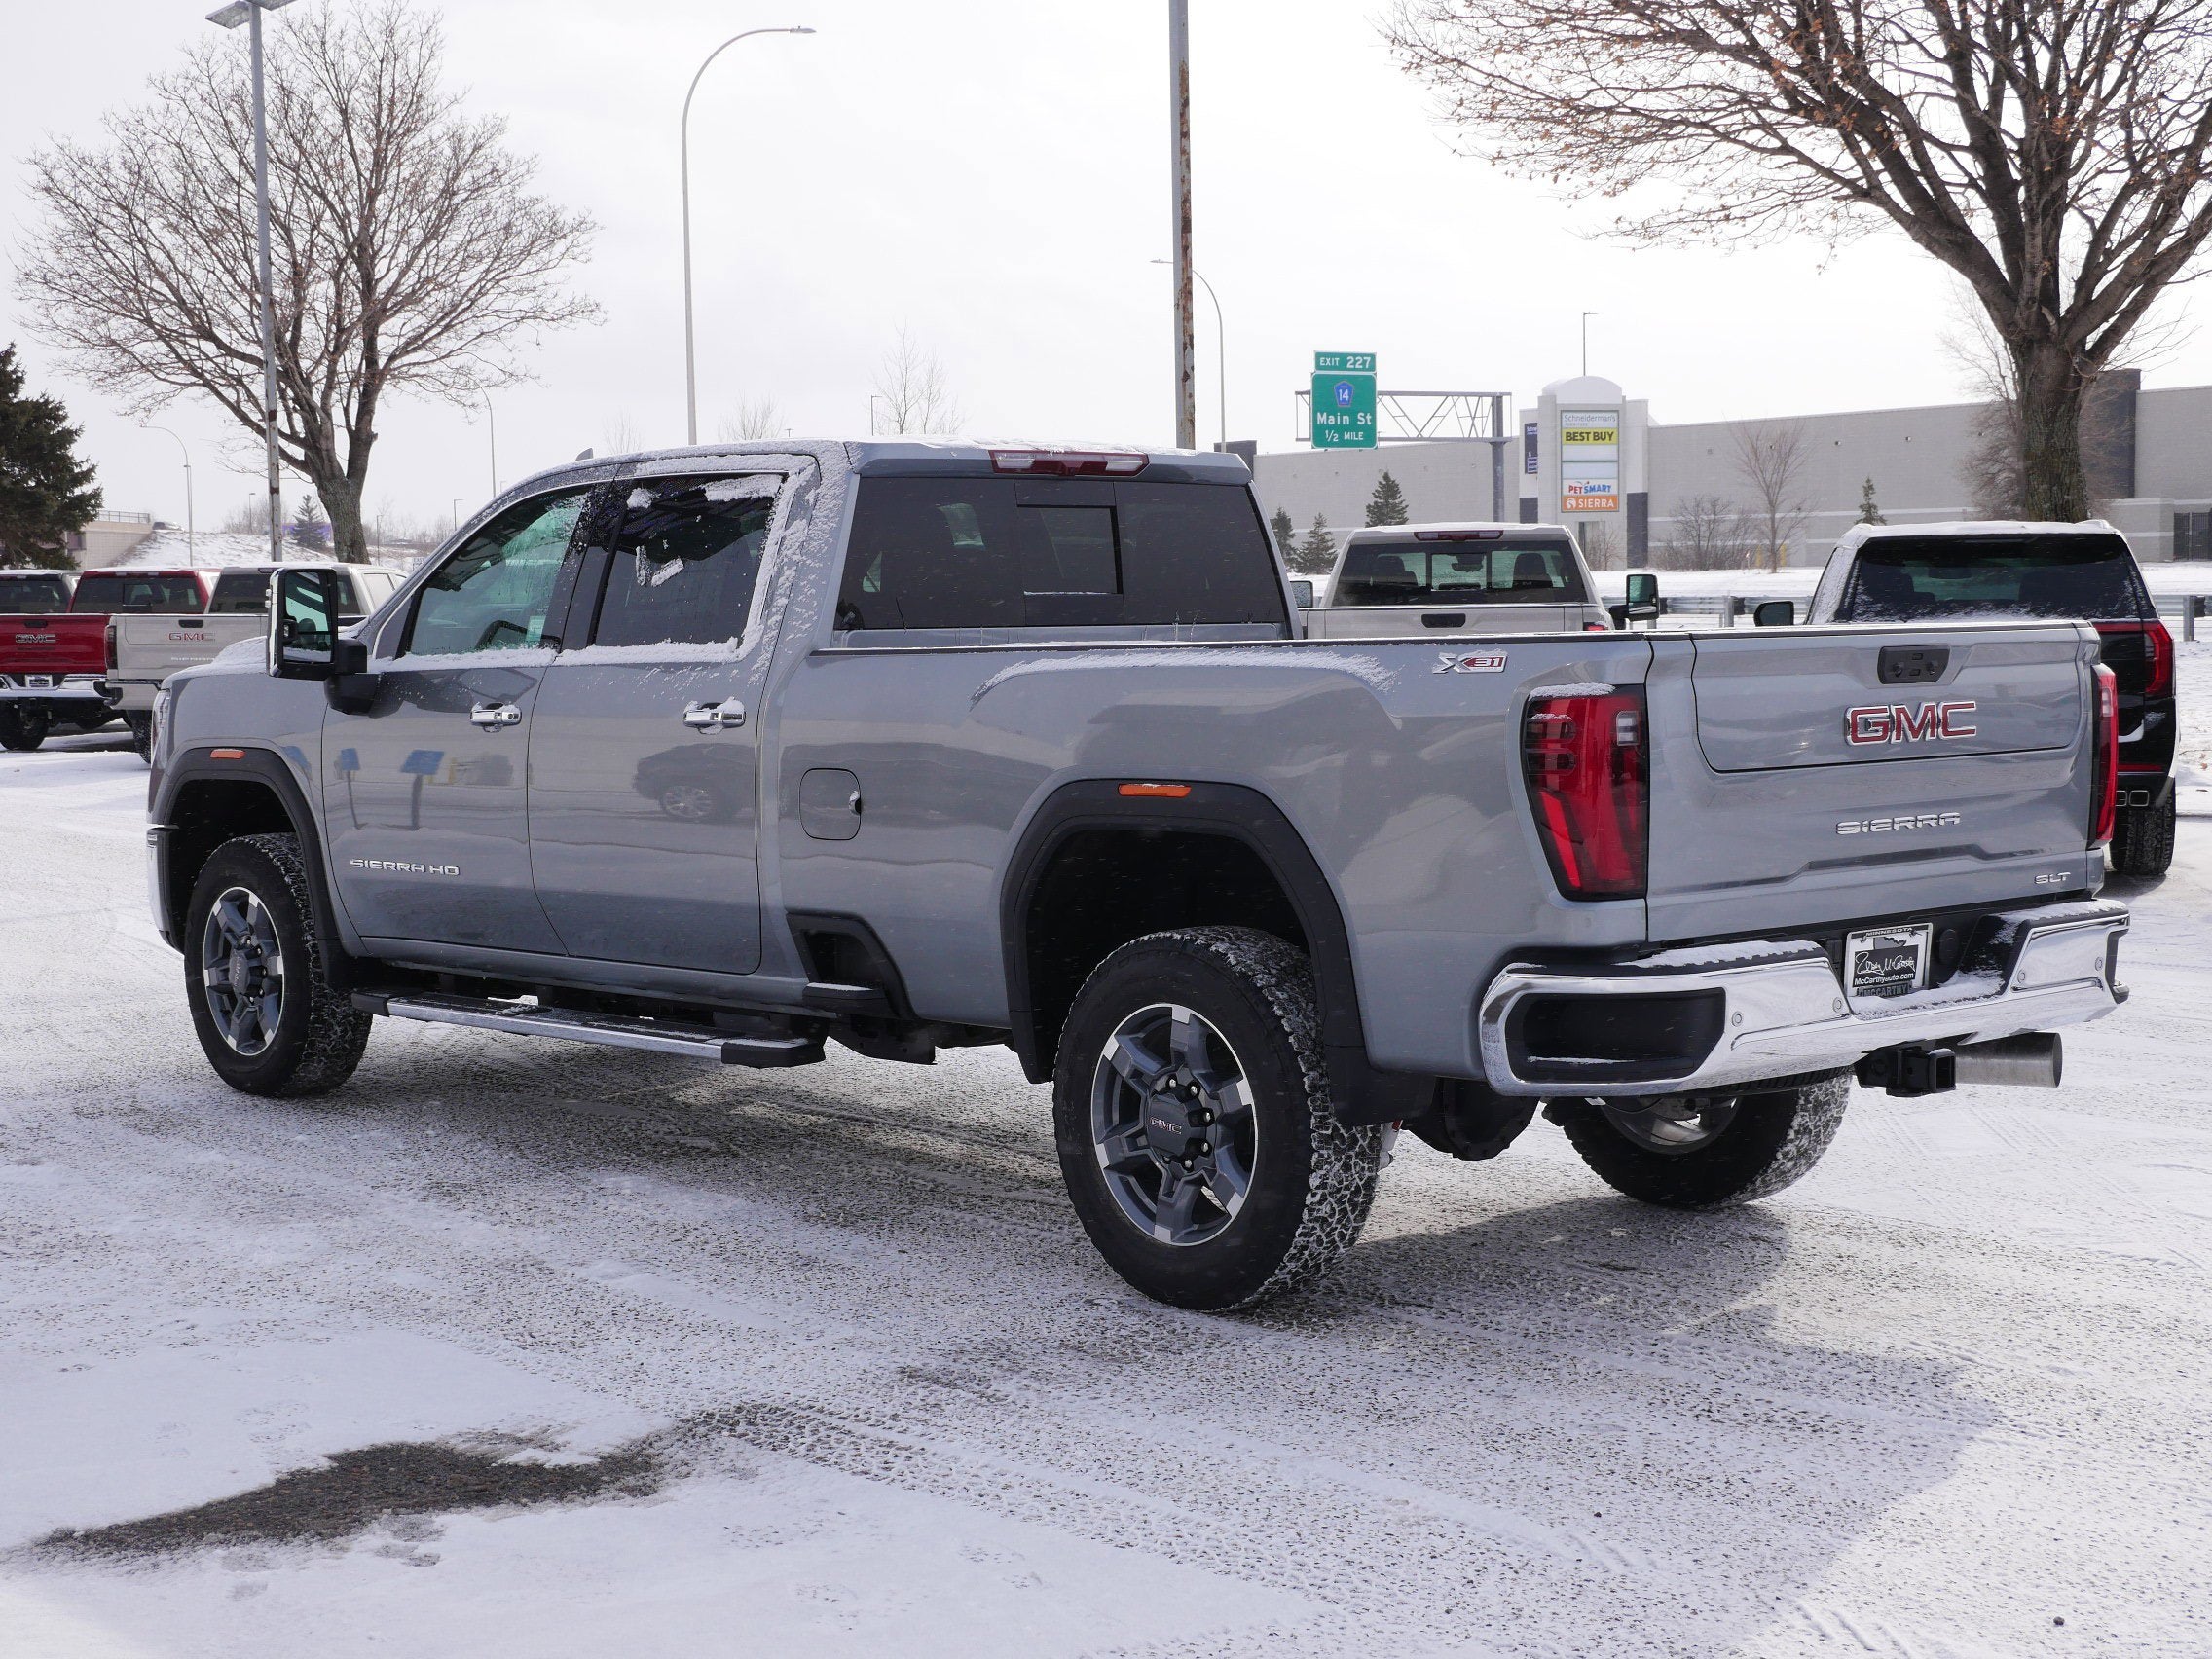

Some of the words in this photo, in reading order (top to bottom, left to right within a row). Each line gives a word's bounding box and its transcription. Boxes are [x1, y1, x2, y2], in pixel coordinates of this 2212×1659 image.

[1319, 357, 1340, 367] EXIT
[1346, 356, 1372, 369] 227
[1339, 388, 1349, 401] 14
[1316, 412, 1350, 425] Main
[1357, 412, 1372, 425] St
[1344, 431, 1364, 440] MILE
[1566, 431, 1591, 441] BEST
[1593, 431, 1614, 441] BUY
[1578, 498, 1614, 508] SIERRA
[16, 634, 56, 643] GMC
[168, 632, 215, 641] GMC
[1432, 650, 1507, 674] X31
[1845, 700, 1977, 746] GMC
[1836, 811, 1961, 835] SIERRA
[350, 859, 425, 873] SIERRA
[429, 865, 460, 876] HD
[2034, 872, 2071, 884] SLT
[1855, 973, 1914, 985] McCarthyauto.com
